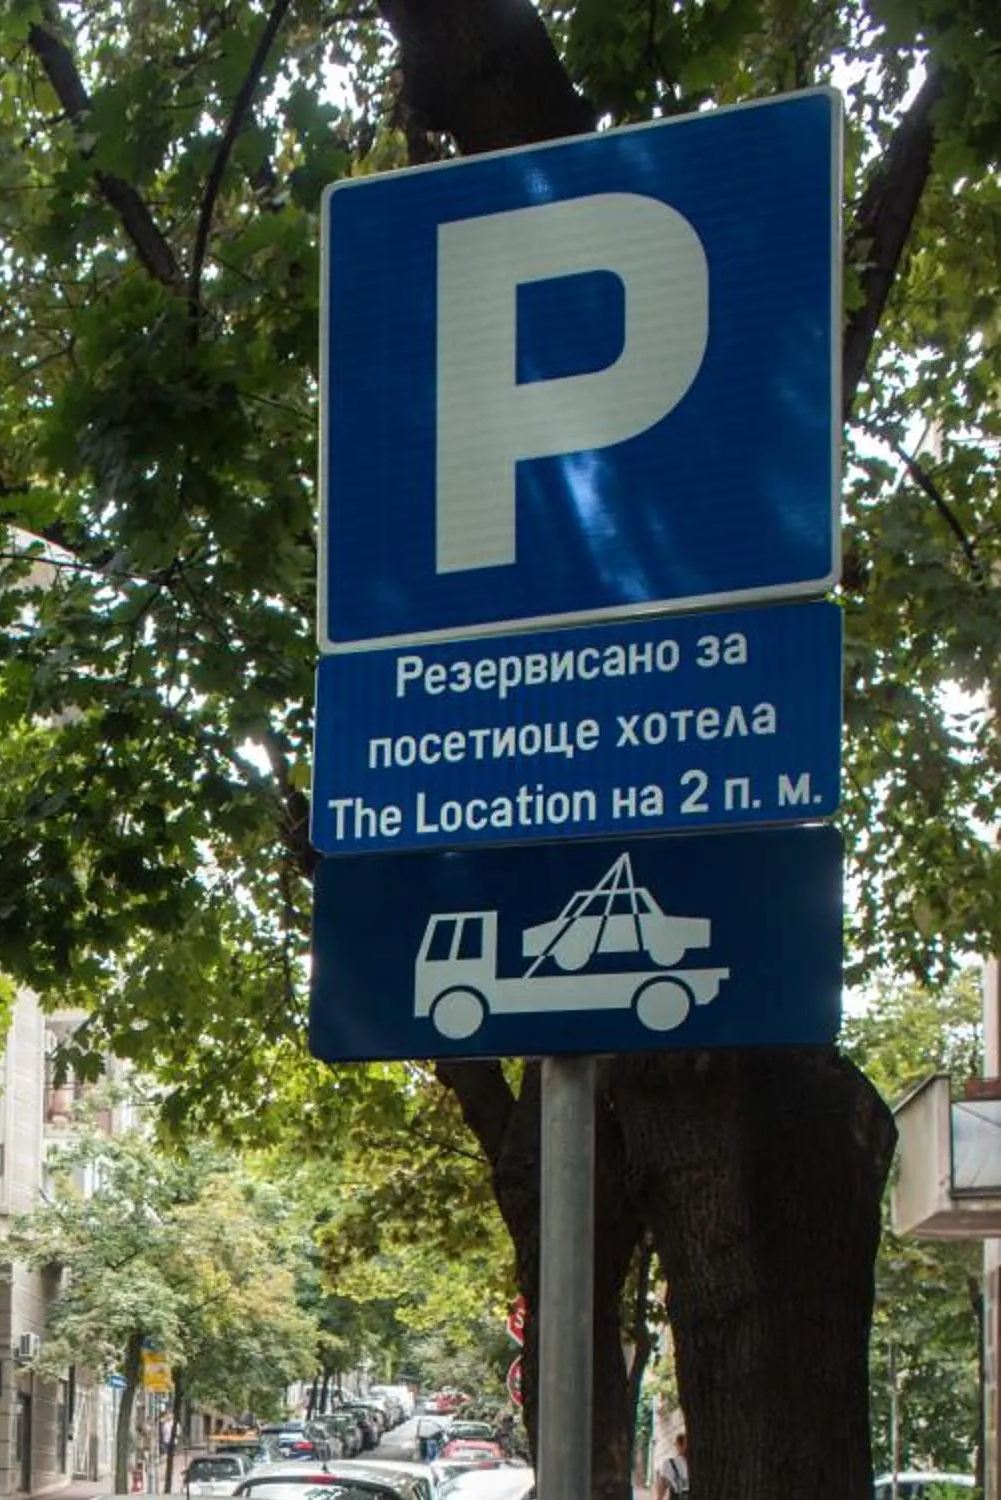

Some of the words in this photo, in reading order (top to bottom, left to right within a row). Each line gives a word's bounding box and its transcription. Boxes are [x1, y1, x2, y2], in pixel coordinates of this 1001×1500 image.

[437, 192, 709, 574] P
[396, 638, 680, 698] Резервисано
[697, 632, 747, 667] за
[369, 718, 600, 769] посетиоце
[616, 703, 776, 747] хотела
[328, 797, 402, 840] The
[416, 784, 596, 833] Location
[612, 785, 664, 819] на
[681, 769, 709, 813] 2
[725, 778, 761, 810] п.
[778, 773, 822, 806] м.
